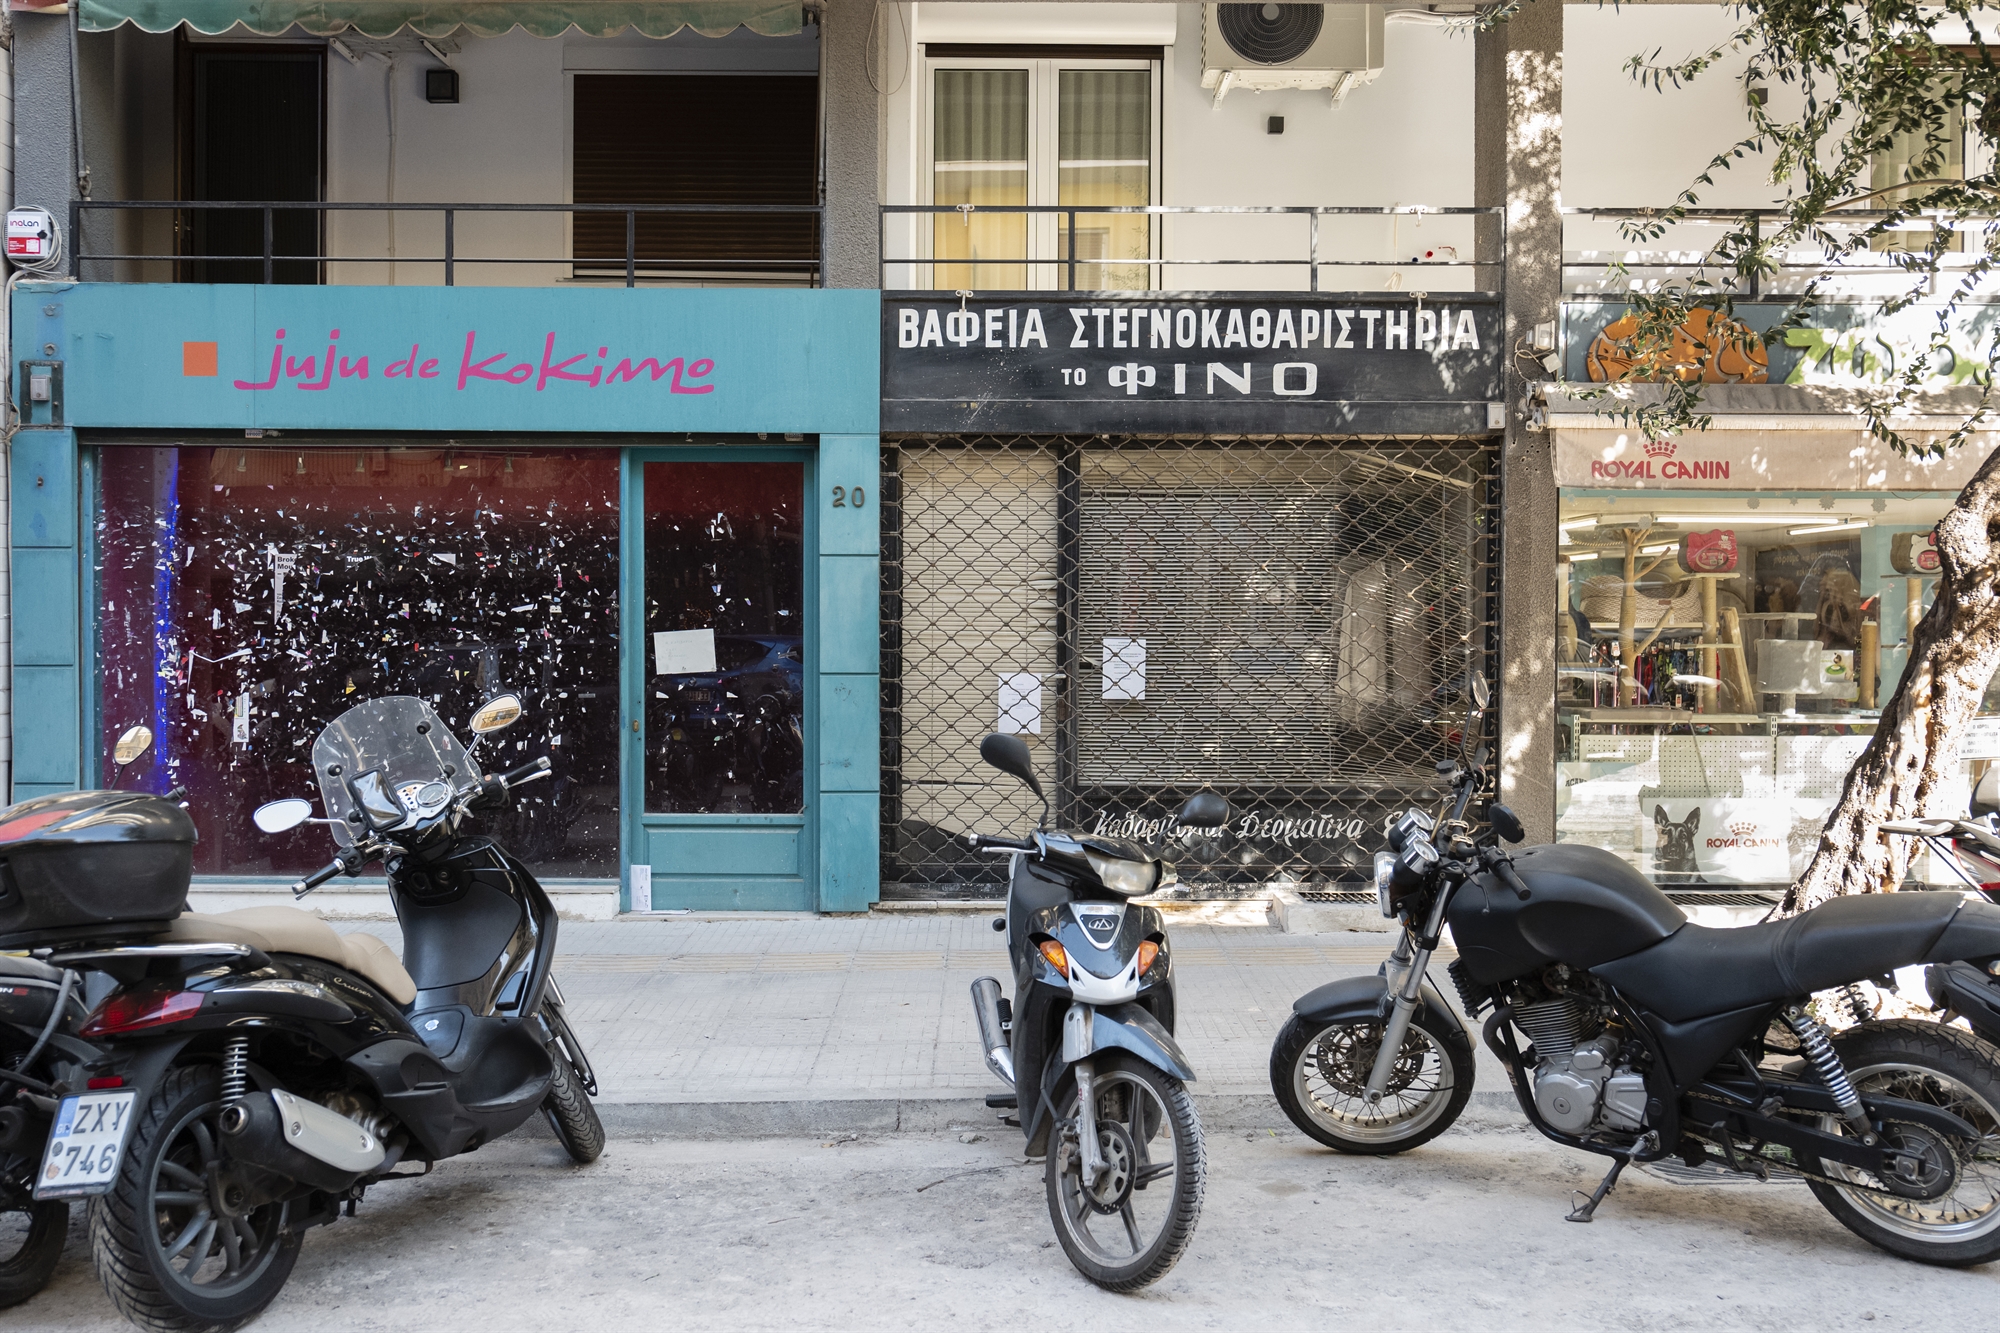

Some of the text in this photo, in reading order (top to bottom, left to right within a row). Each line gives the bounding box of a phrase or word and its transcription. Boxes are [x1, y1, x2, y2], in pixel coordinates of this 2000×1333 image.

[898, 308, 1481, 350] ΒΑΦΕΙΑ ΣΤΕΓΝΟΚΑΘΑΡΙΣΤΗΡΙΑ
[234, 328, 370, 391] juju
[384, 344, 439, 378] de
[1108, 362, 1318, 396] ΦΙΝΟ
[1591, 460, 1730, 480] ROYAL CANIN
[832, 485, 865, 508] 20
[1706, 838, 1779, 848] ROYAL CANIN
[333, 976, 374, 999] Cruiser
[72, 1101, 130, 1135] ZXY
[63, 1143, 117, 1177] 746
